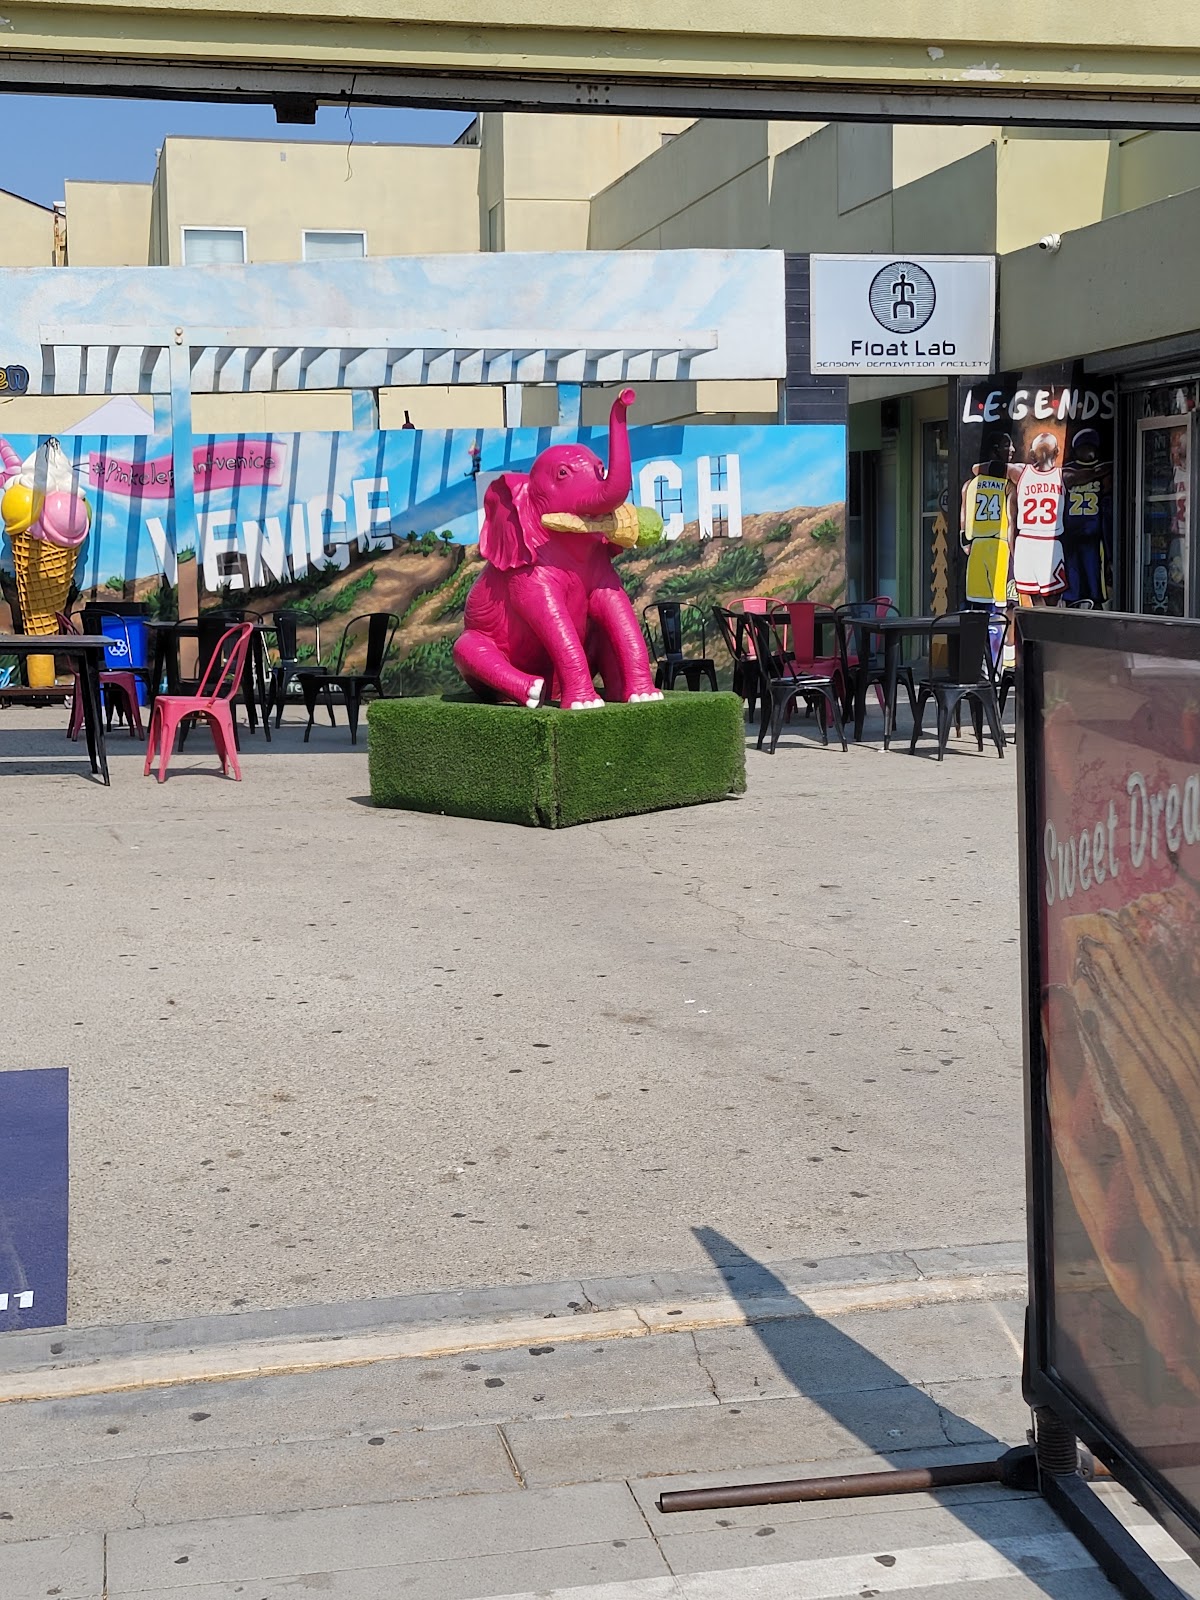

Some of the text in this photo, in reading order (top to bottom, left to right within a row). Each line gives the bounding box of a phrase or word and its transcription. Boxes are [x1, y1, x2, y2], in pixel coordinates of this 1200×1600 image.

[851, 340, 956, 356] Float Lab
[976, 481, 1005, 491] BRYANT
[1024, 483, 1063, 495] JORDAN
[975, 493, 1000, 521] 24
[1023, 498, 1057, 524] 23
[1069, 492, 1099, 516] 23
[1043, 799, 1119, 906] Sweet
